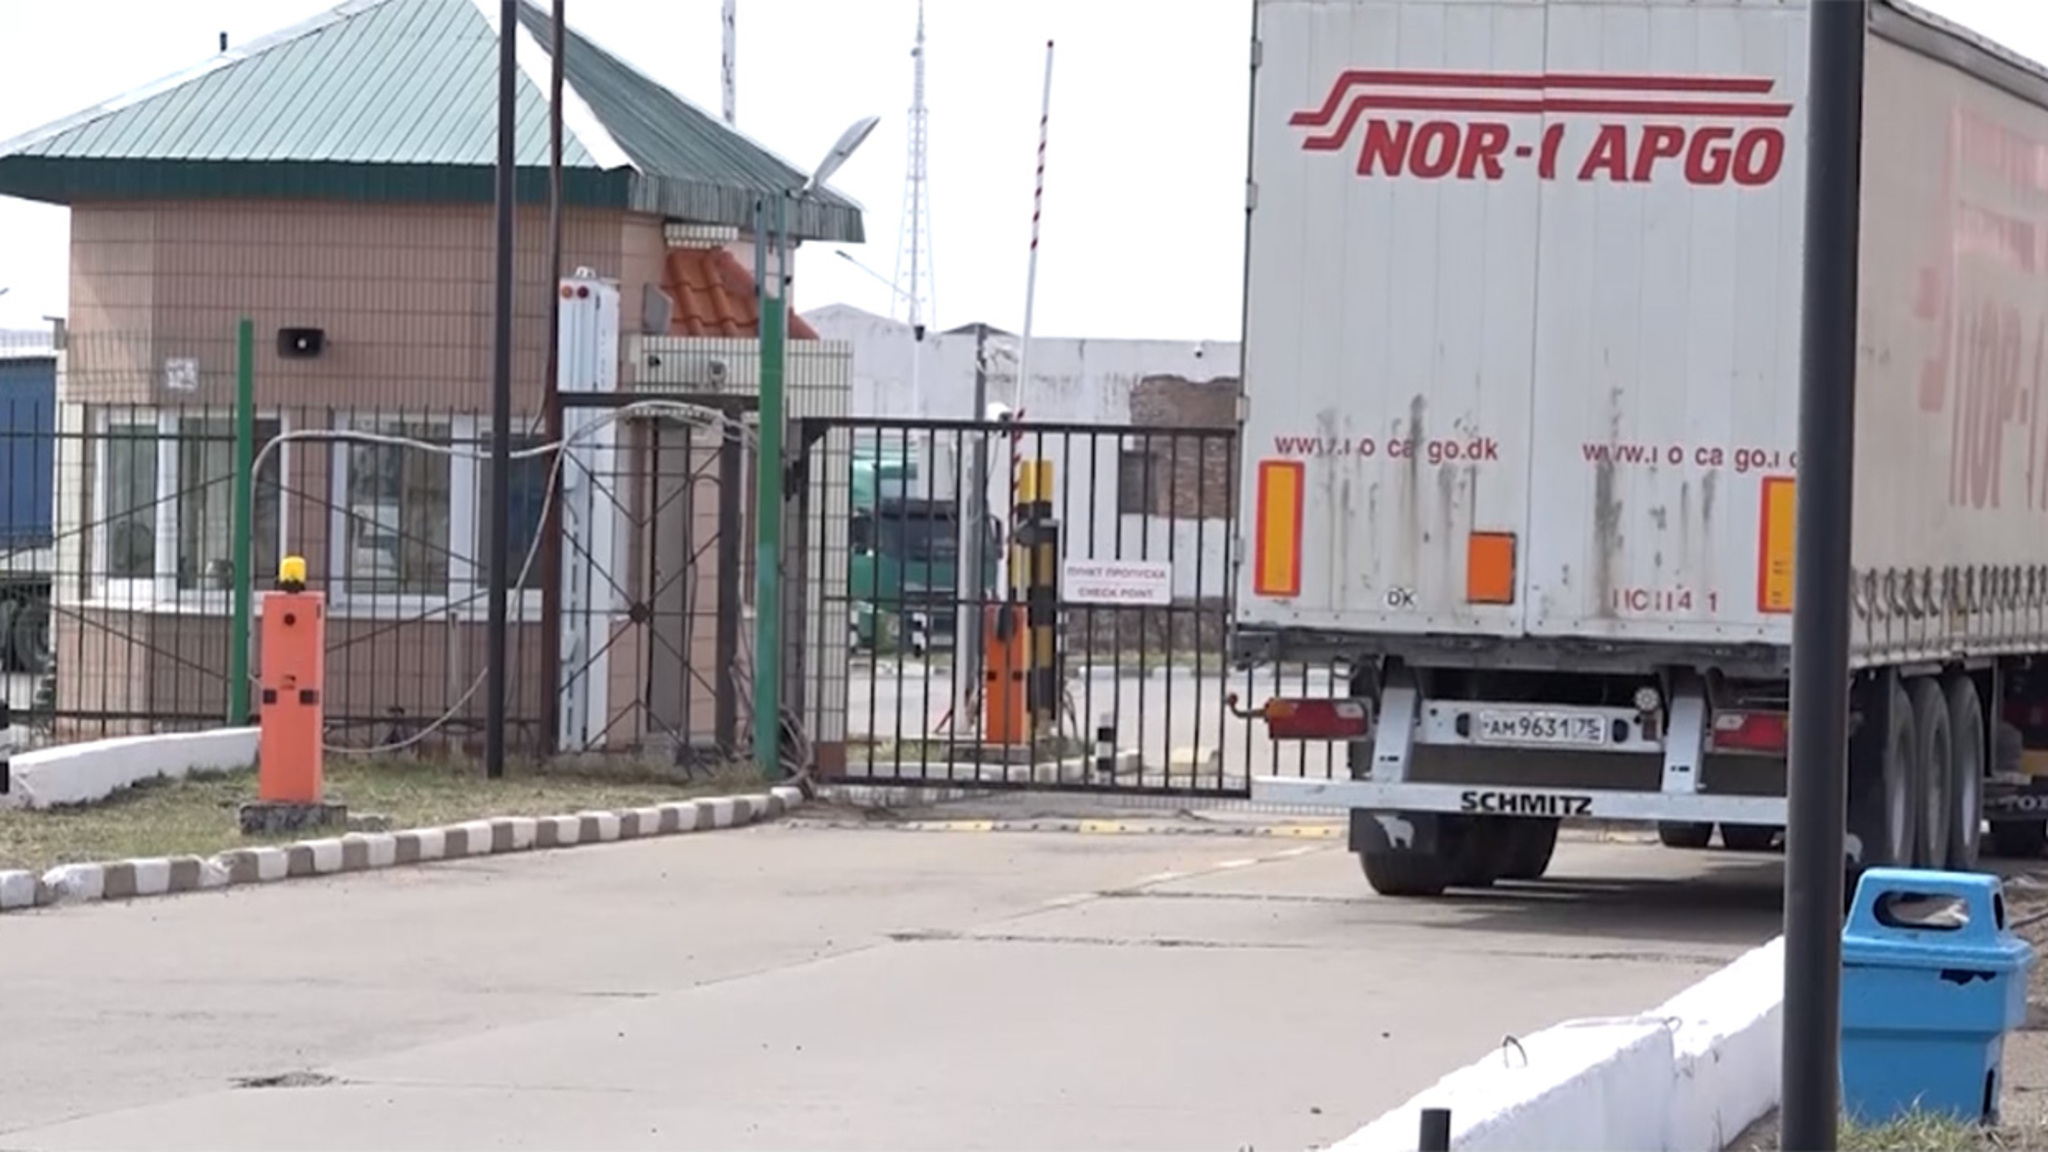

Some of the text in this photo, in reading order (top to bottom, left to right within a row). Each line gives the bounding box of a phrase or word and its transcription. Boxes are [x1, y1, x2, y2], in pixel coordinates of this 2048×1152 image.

[1067, 566, 1166, 580] ПУНКТ ПРОПУСКА
[1077, 586, 1153, 599] CHECK POINT
[1387, 589, 1416, 607] DK
[1460, 790, 1593, 816] SCHMITZ
